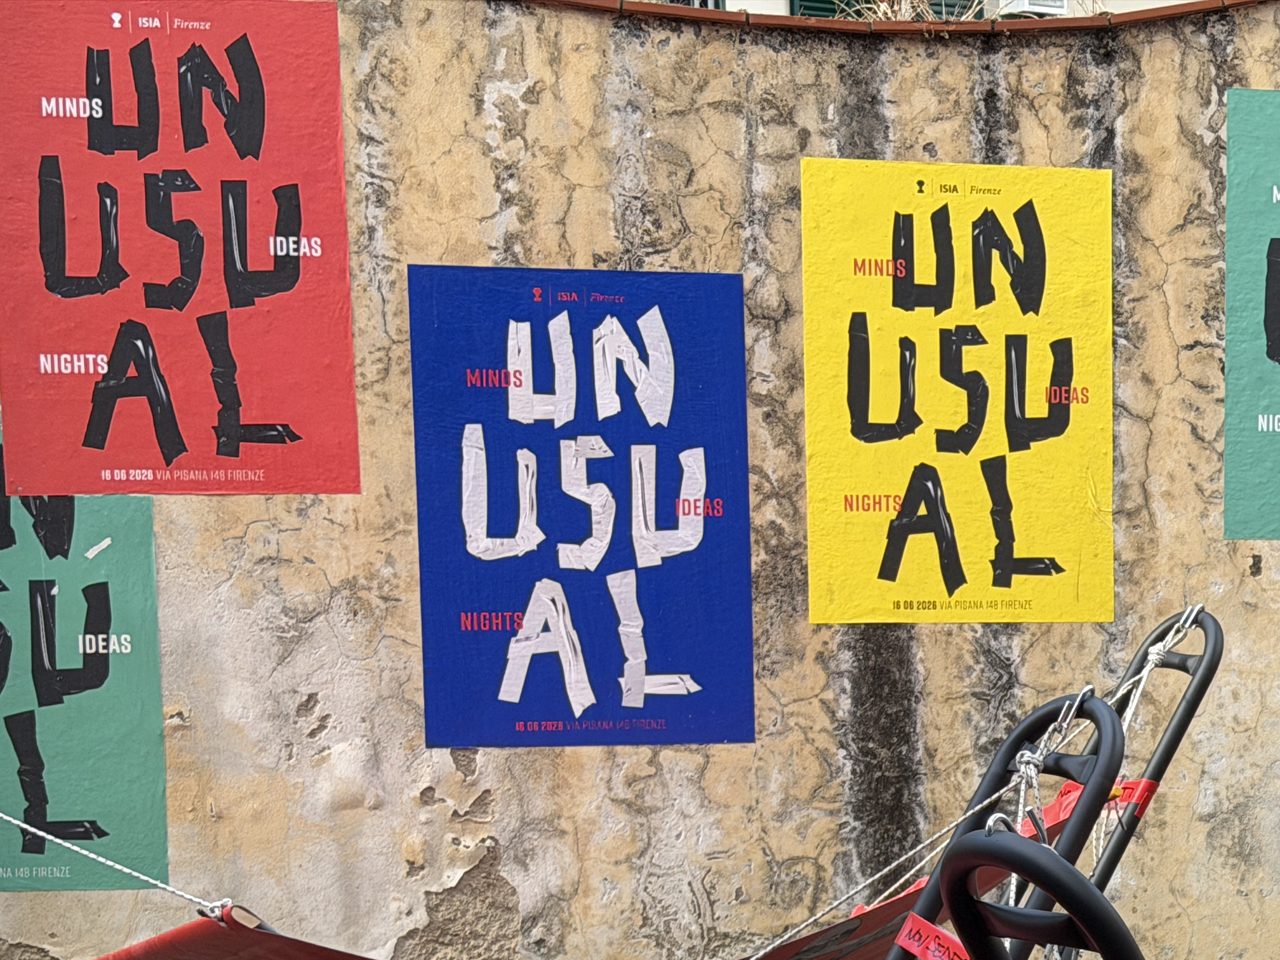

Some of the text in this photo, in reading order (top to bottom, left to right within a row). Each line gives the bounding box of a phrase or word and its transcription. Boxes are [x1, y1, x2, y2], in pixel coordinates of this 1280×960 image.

[138, 17, 211, 30] ISIA Firenze
[41, 96, 103, 119] MINDS
[940, 184, 1002, 195] ISIA Firenze
[269, 236, 322, 258] IDEAS
[853, 258, 906, 277] MINDS
[39, 352, 109, 375] NIGHTS
[466, 369, 523, 388] MINDS
[82, 311, 303, 467] AL
[1045, 386, 1089, 404] IDEAS
[156, 469, 171, 481] VIA
[174, 469, 209, 481] PISANA
[228, 469, 265, 481] FIRENZE
[675, 498, 724, 517] IDEAS
[843, 494, 902, 513] NIGHTS
[877, 455, 1066, 598] AL
[892, 600, 901, 610] 16
[903, 600, 914, 610] 06
[916, 600, 937, 610] 2026
[939, 600, 952, 610] VIA
[955, 600, 984, 610] PISANA
[1000, 600, 1033, 610] FIRENZE
[460, 611, 525, 631] NIGHTS
[78, 634, 132, 654] IDEAS
[497, 569, 703, 719] AL
[32, 866, 71, 878] FIRENZE
